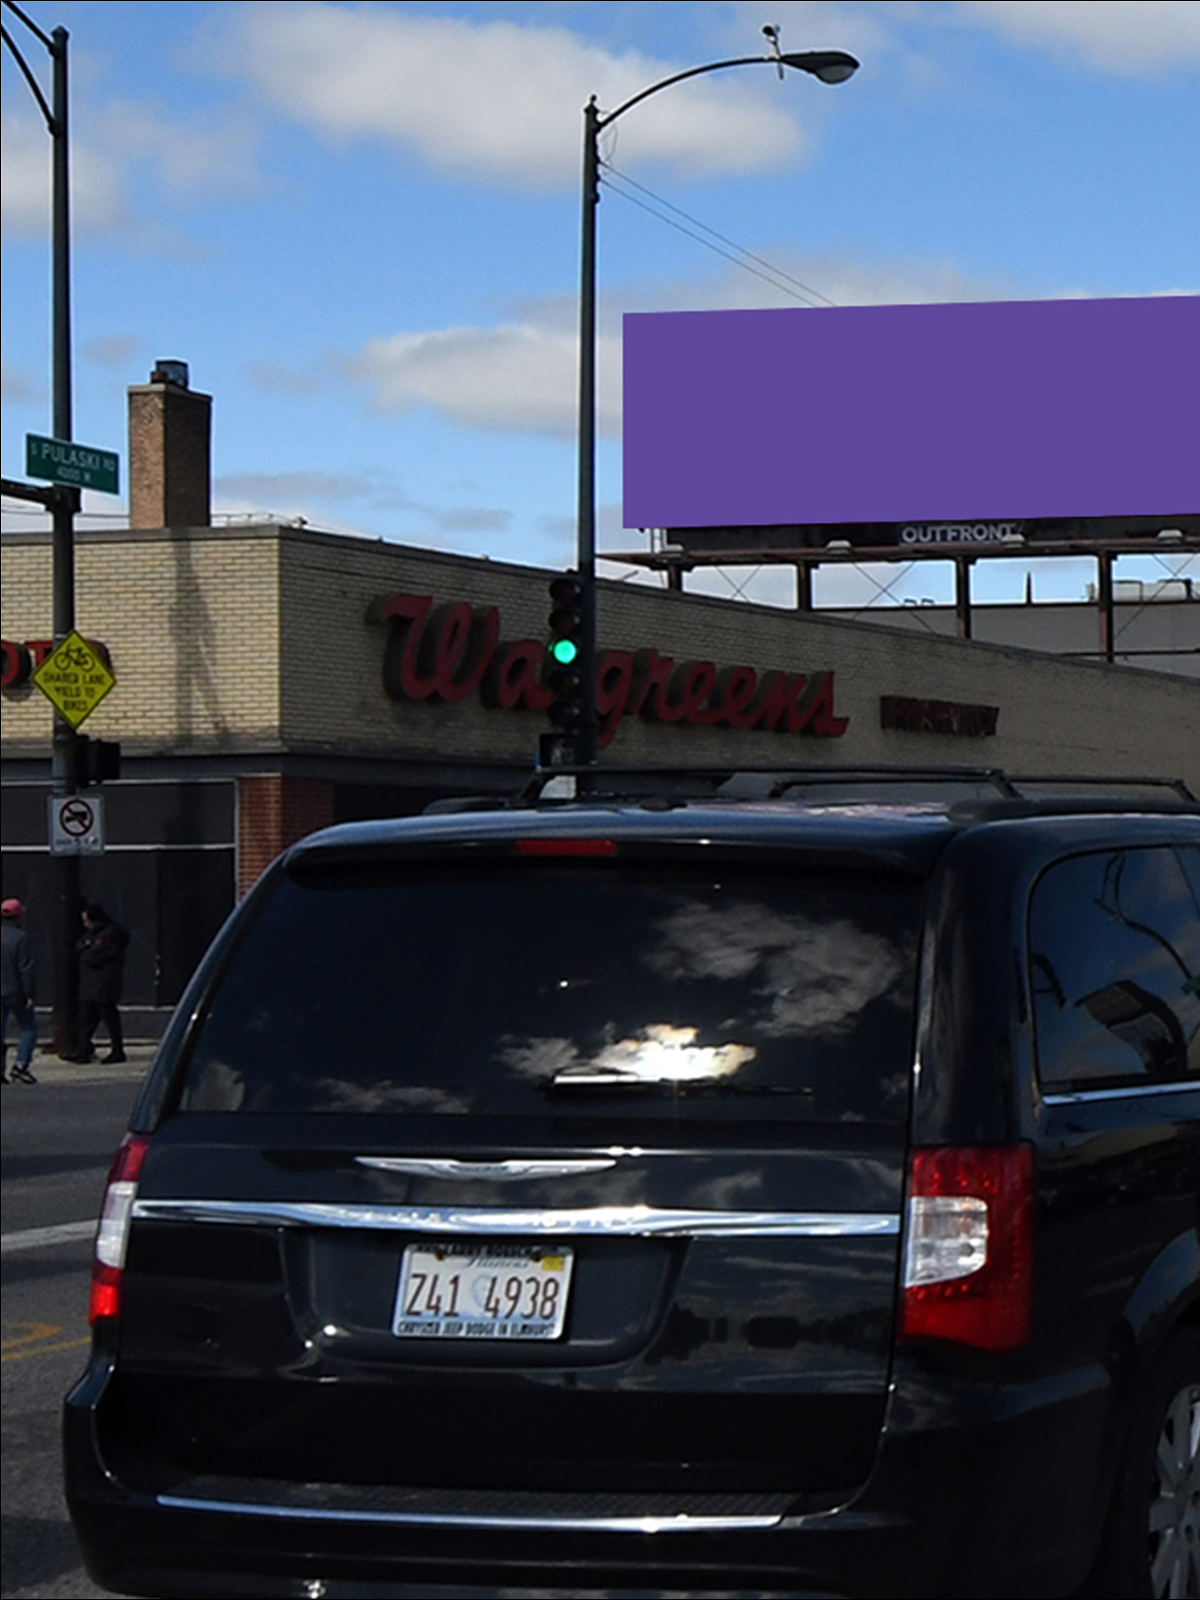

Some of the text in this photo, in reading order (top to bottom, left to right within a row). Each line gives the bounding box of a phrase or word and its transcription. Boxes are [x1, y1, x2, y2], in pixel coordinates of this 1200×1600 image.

[42, 443, 100, 471] PULASKI
[902, 523, 1018, 543] OUTFRONT
[383, 594, 849, 749] Wagreens
[405, 1274, 560, 1320] Z41 4938
